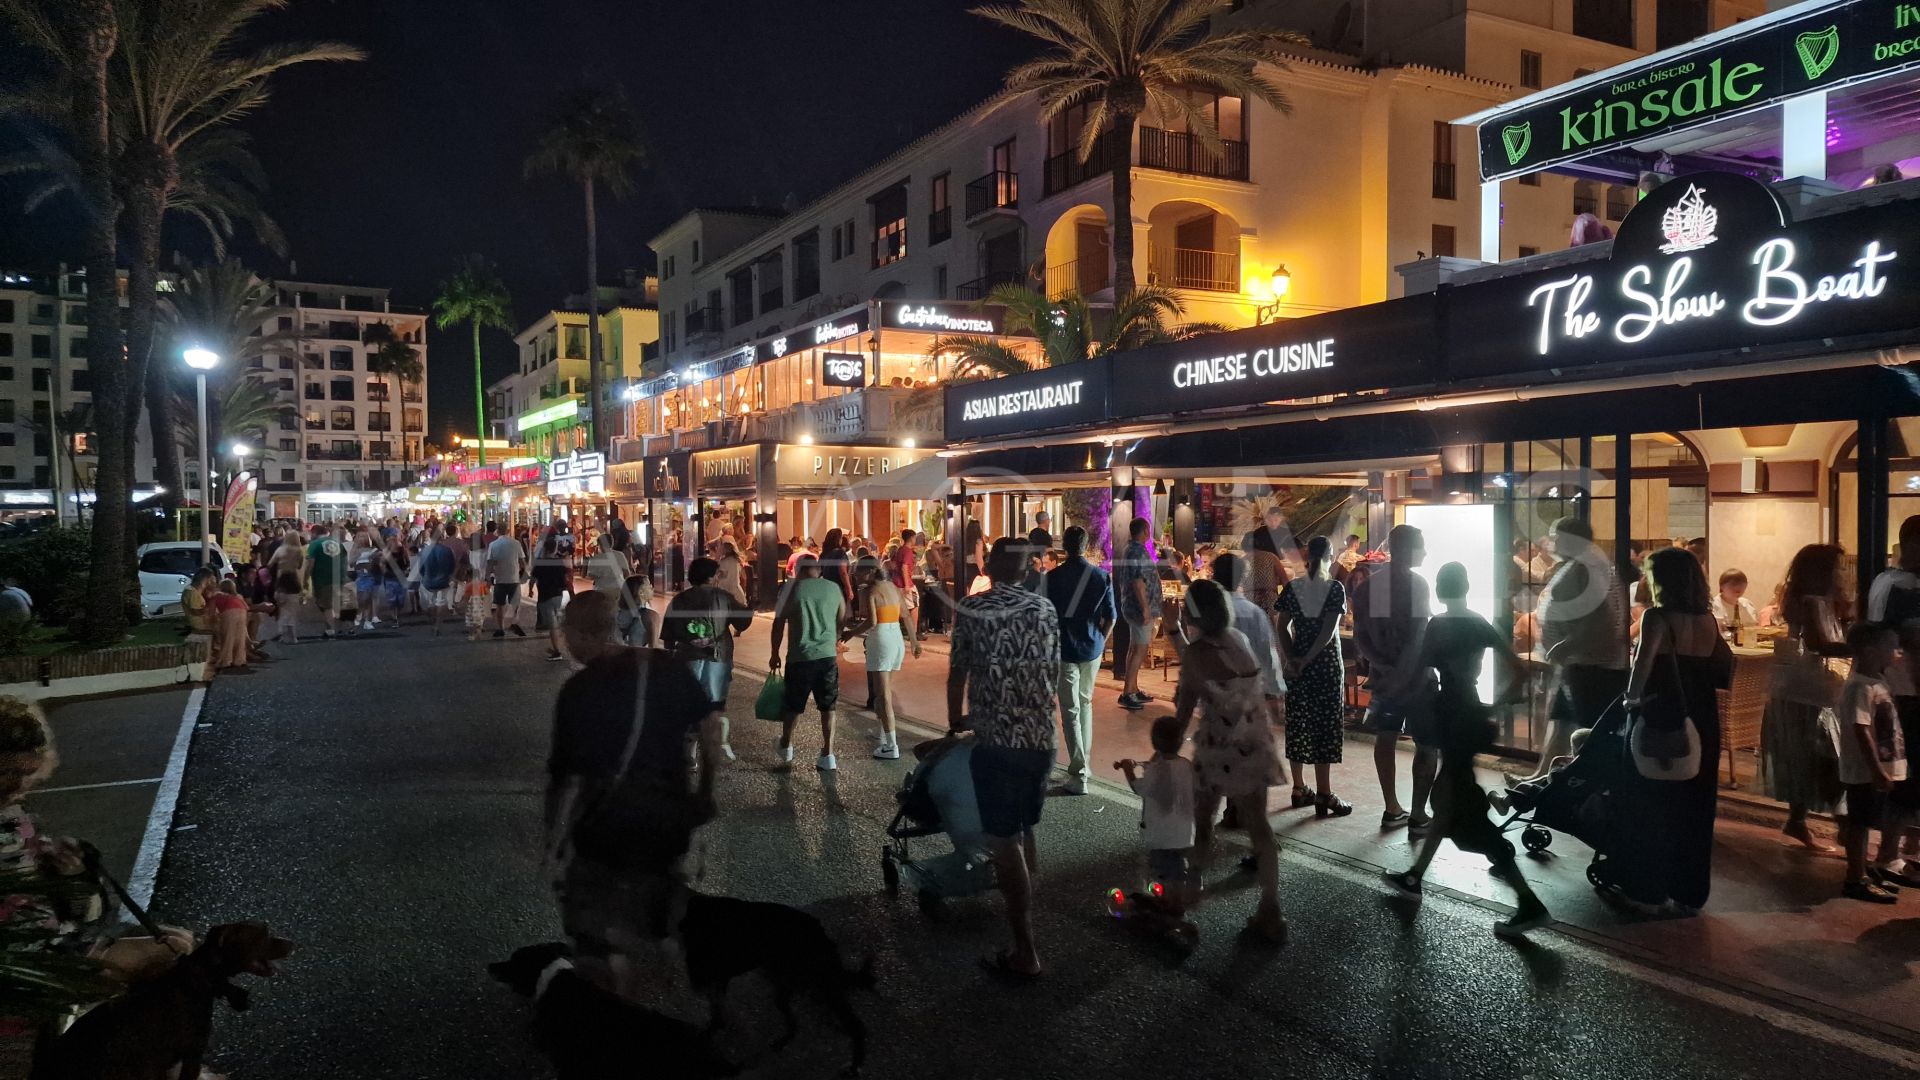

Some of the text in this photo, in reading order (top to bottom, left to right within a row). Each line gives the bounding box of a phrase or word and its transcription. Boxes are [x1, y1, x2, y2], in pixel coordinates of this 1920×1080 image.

[1612, 79, 1638, 96] bar
[1649, 62, 1696, 83] bistro
[1561, 58, 1765, 151] kinsale
[1528, 237, 1899, 356] The Slow Boat
[1173, 338, 1336, 389] CHINESE CUISINE
[963, 380, 1084, 422] ASIAN RESTAURANT
[703, 455, 750, 478] RISTORANTE
